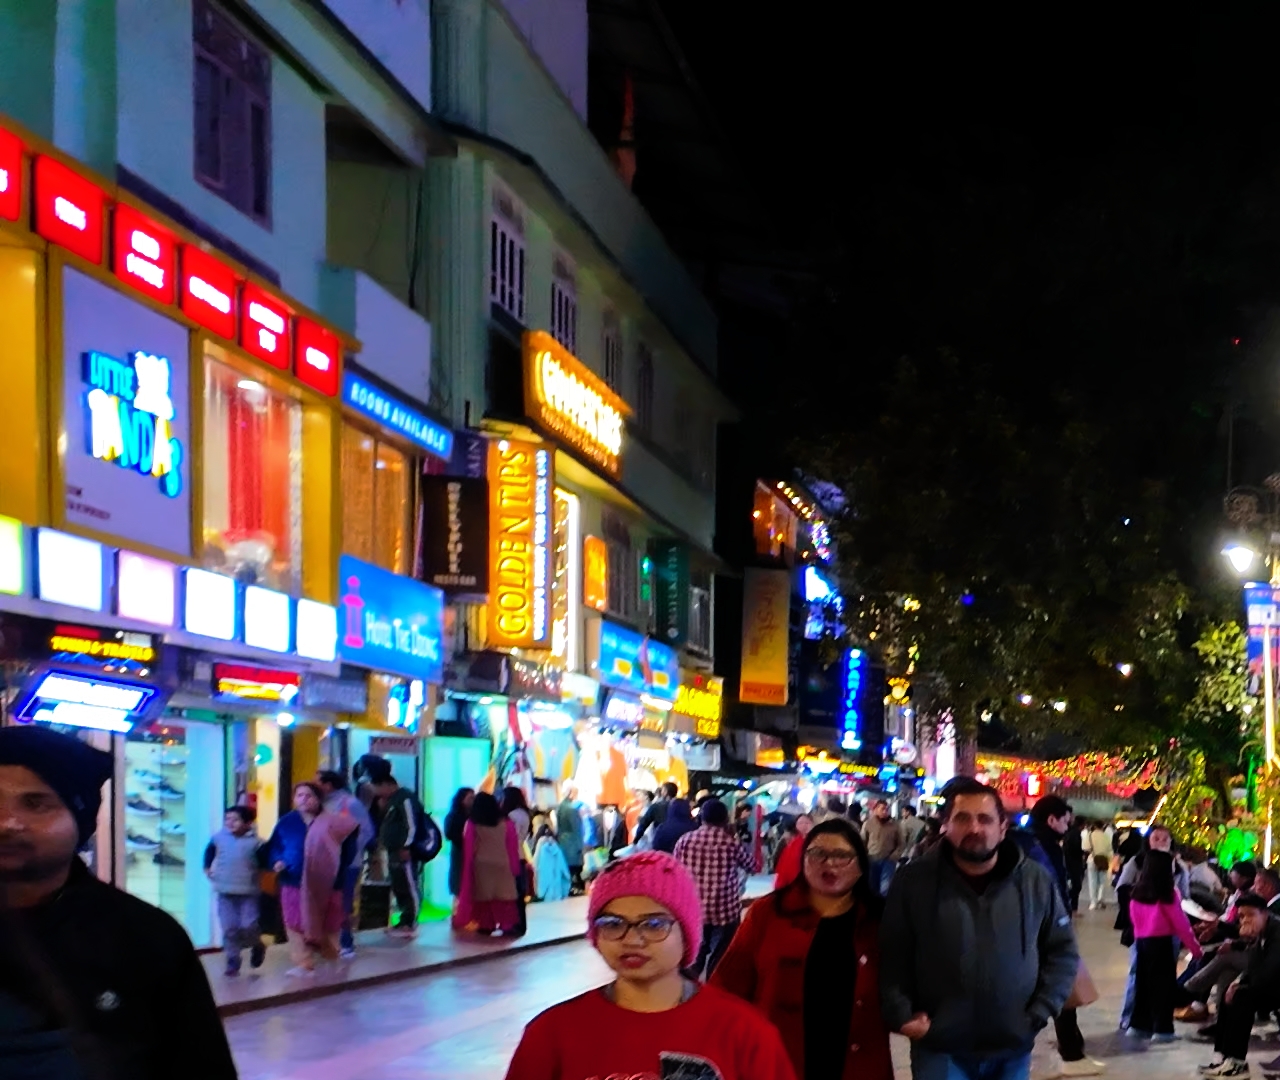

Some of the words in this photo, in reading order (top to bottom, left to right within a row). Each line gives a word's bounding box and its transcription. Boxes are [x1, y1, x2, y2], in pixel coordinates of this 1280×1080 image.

[351, 382, 390, 420] ROOMS
[390, 407, 447, 452] AVAILABLE
[500, 450, 531, 507] TIPS
[498, 516, 531, 637] GOLDEN
